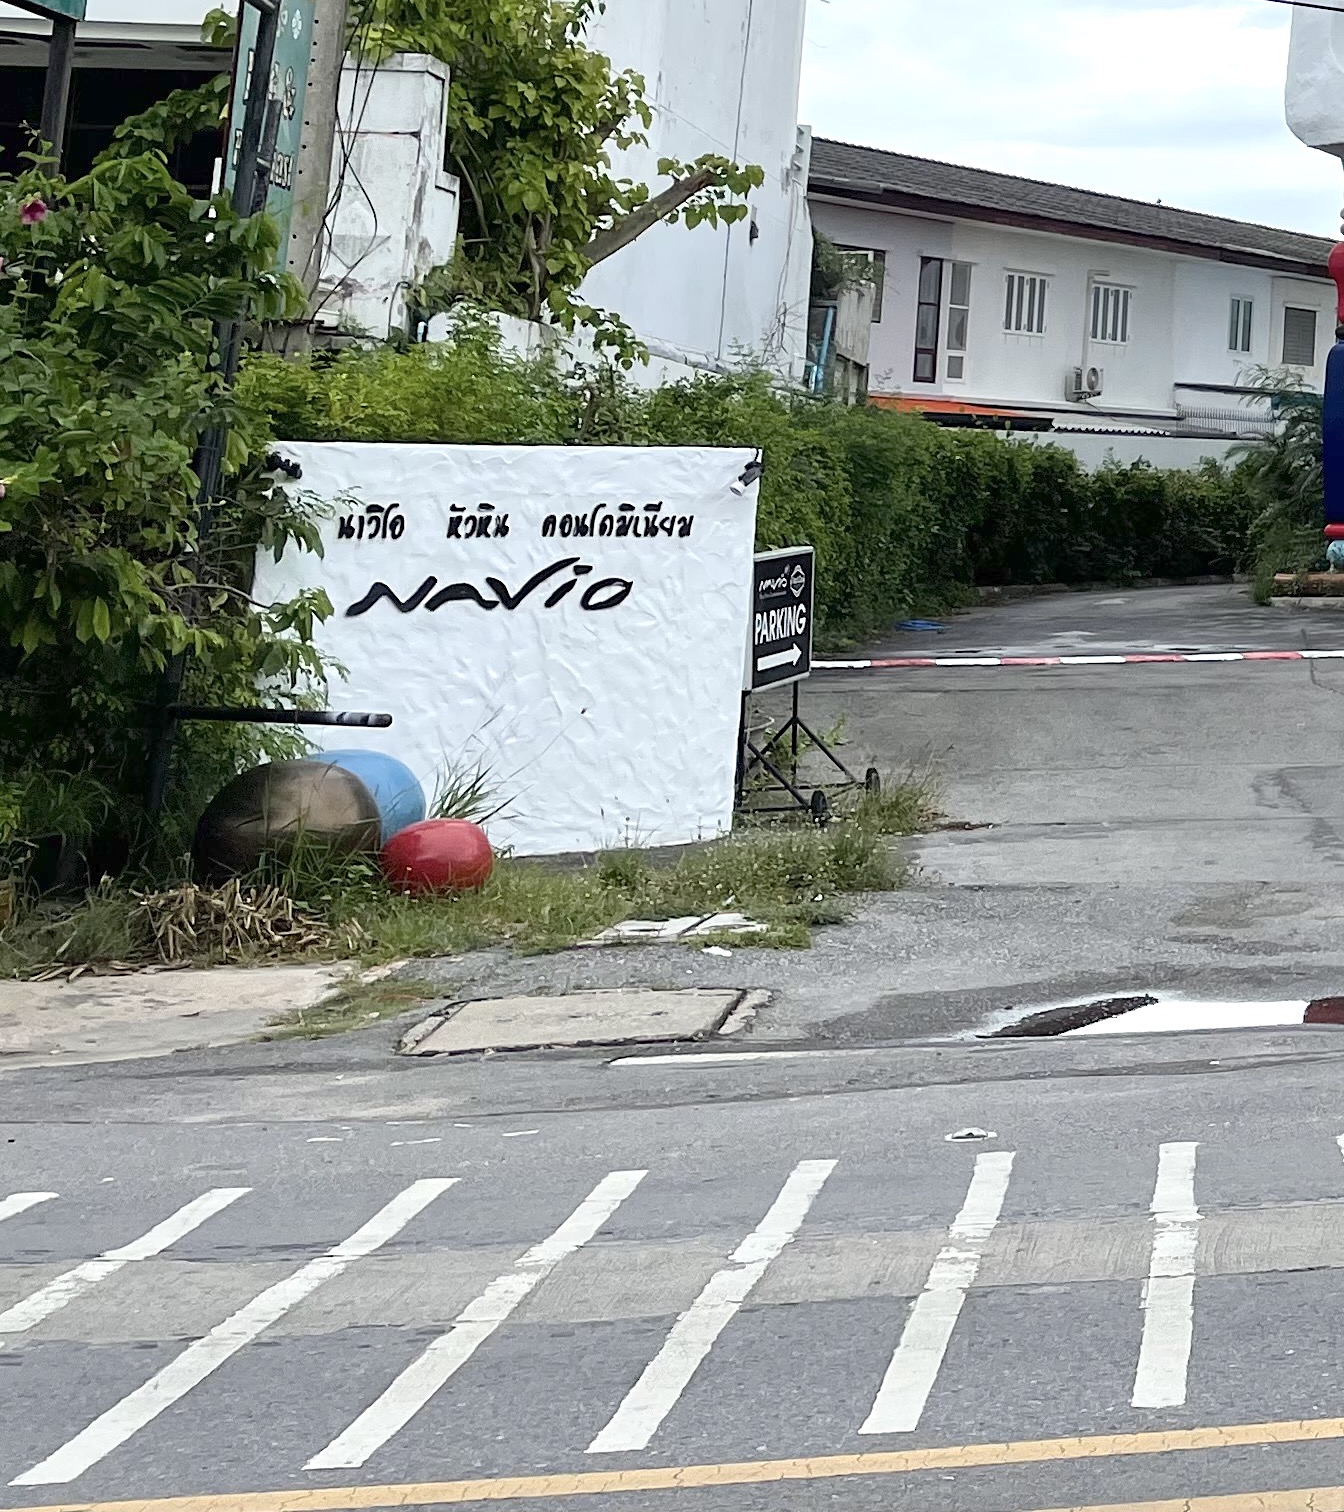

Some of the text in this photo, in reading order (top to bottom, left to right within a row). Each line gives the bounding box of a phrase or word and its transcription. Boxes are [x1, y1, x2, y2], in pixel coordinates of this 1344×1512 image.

[446, 503, 510, 539] หัวหิน
[541, 501, 695, 538] คอนโดมิเนียม
[755, 603, 807, 645] PARKING
